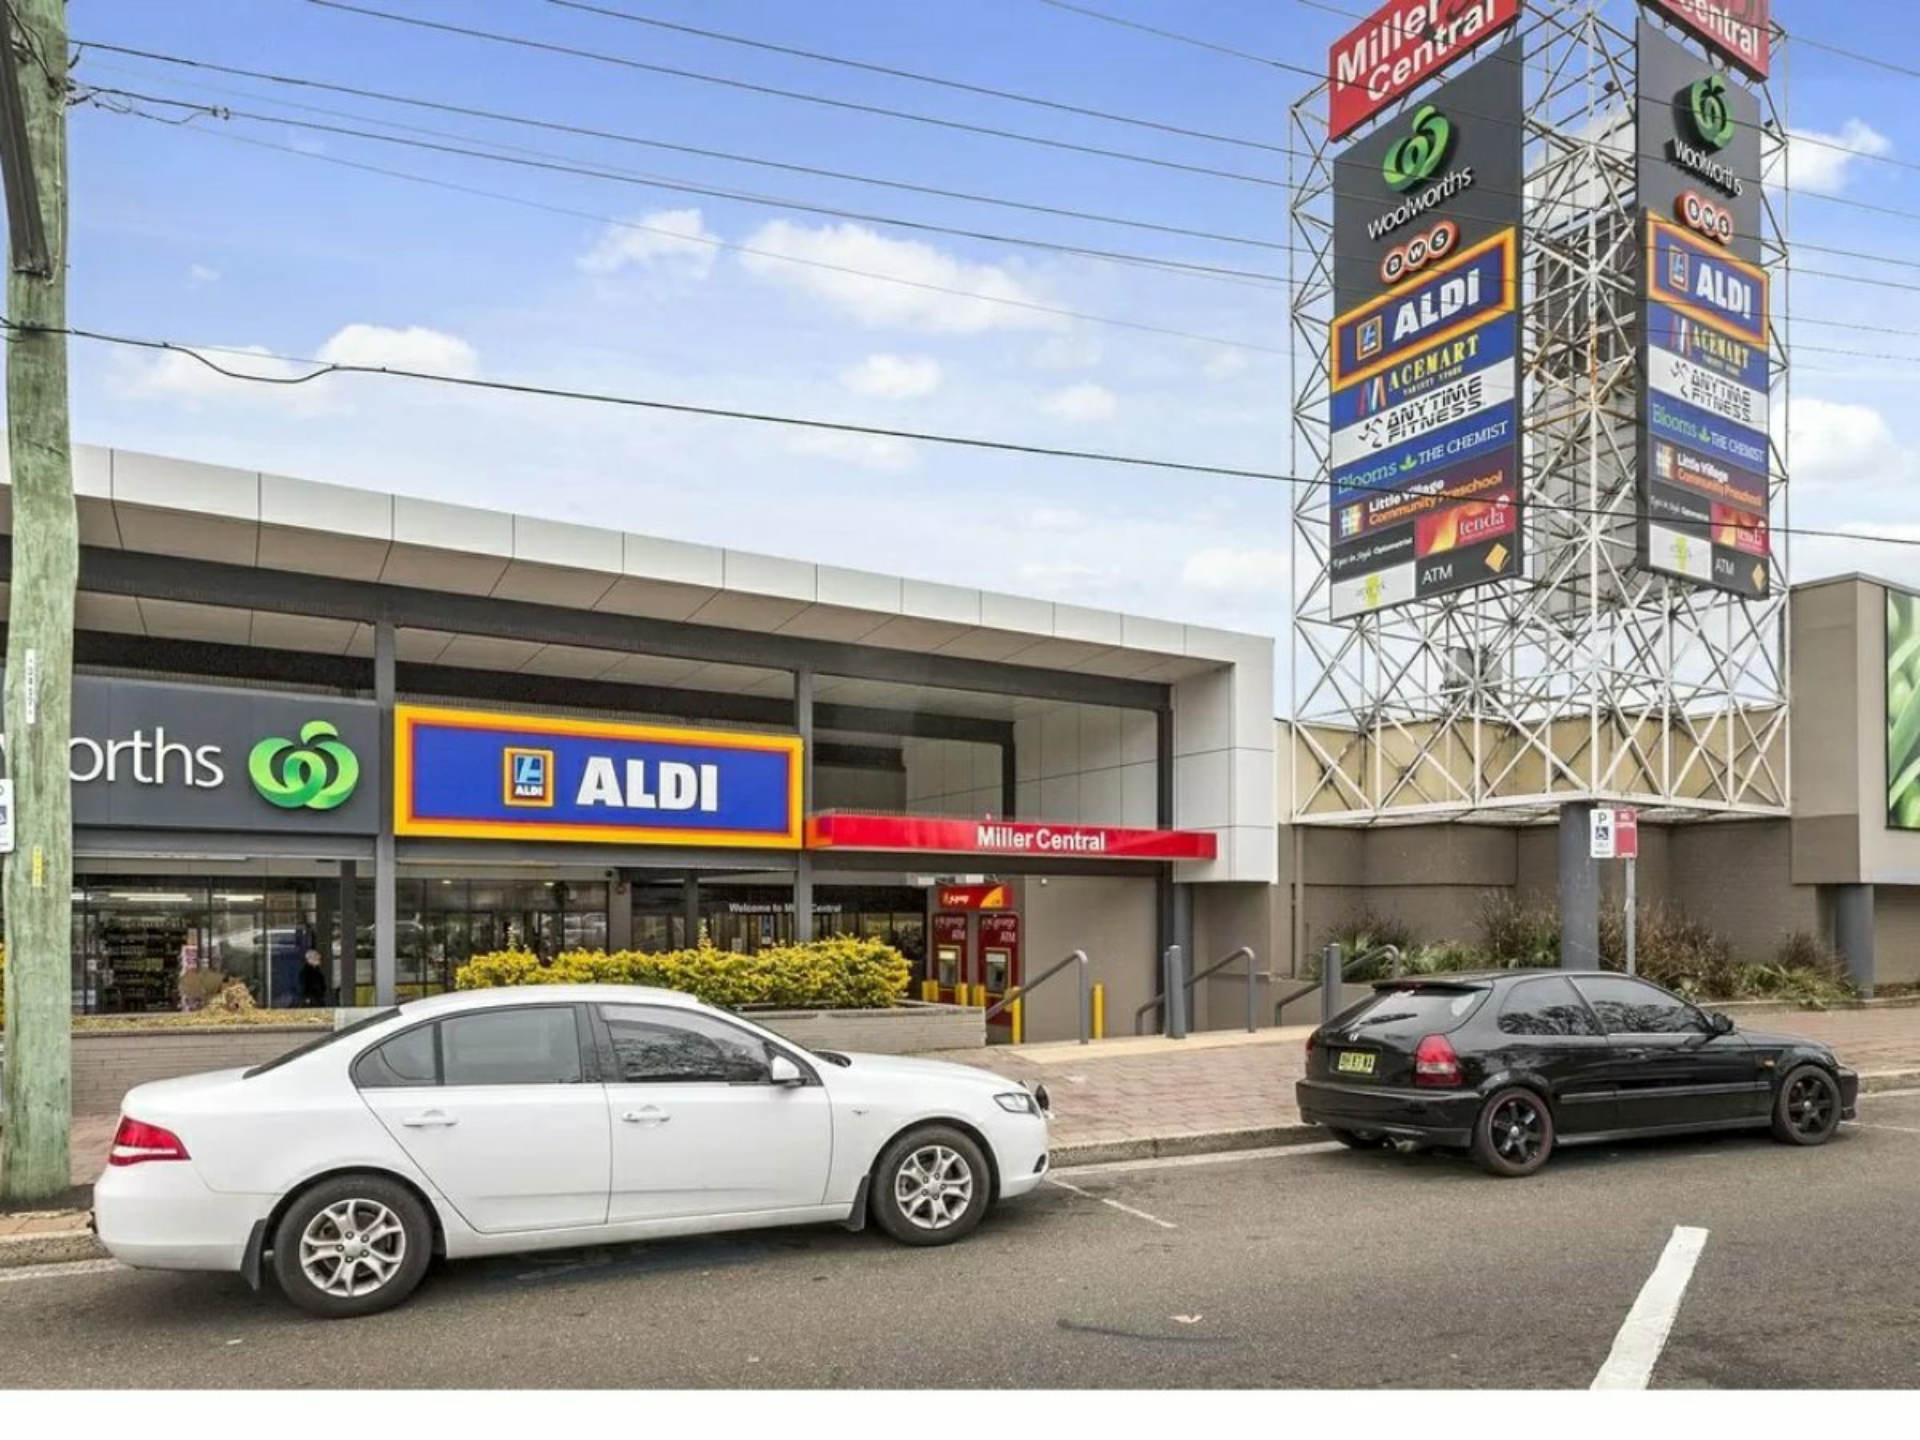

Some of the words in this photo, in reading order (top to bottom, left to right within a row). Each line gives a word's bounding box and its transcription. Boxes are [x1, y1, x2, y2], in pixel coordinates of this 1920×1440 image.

[1337, 0, 1438, 92] Miller
[1367, 0, 1494, 101] Central
[1367, 166, 1472, 241] Woolworths
[1393, 268, 1479, 342] ALDI
[1696, 262, 1751, 319] ALDI
[1389, 334, 1479, 392] ACEMART
[1388, 376, 1482, 430] ANYTIME
[1388, 394, 1482, 442] FITNESS
[1653, 403, 1698, 438] Blooms
[1338, 463, 1397, 495] Blooms
[1418, 444, 1445, 465] THE
[1447, 421, 1508, 453] CHEMIST
[1369, 494, 1401, 512] Little
[1369, 494, 1436, 525] Community
[1422, 564, 1453, 585] ATM
[1715, 558, 1735, 576] ATM
[515, 786, 543, 797] ALDI
[576, 756, 718, 812] ALDI
[977, 826, 1034, 848] Miller
[1036, 829, 1105, 850] Central
[729, 903, 771, 913] Welcome
[772, 903, 783, 913] to
